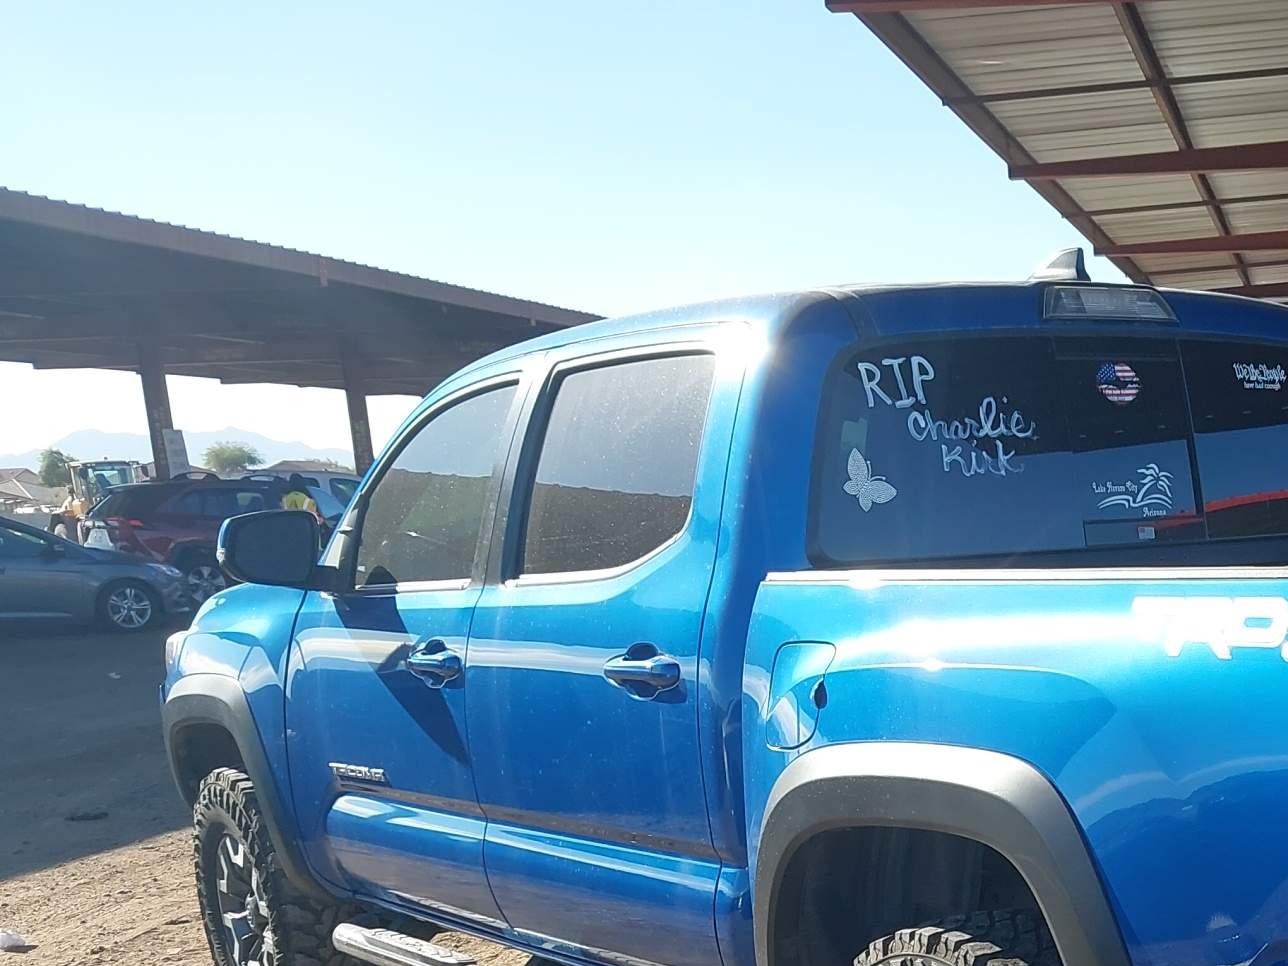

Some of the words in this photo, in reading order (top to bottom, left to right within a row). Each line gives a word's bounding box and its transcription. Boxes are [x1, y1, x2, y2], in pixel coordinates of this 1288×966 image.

[857, 355, 935, 409] RIP
[907, 396, 1037, 441] Charlie
[941, 440, 1024, 477] Kirk
[328, 762, 385, 782] TACOMA
